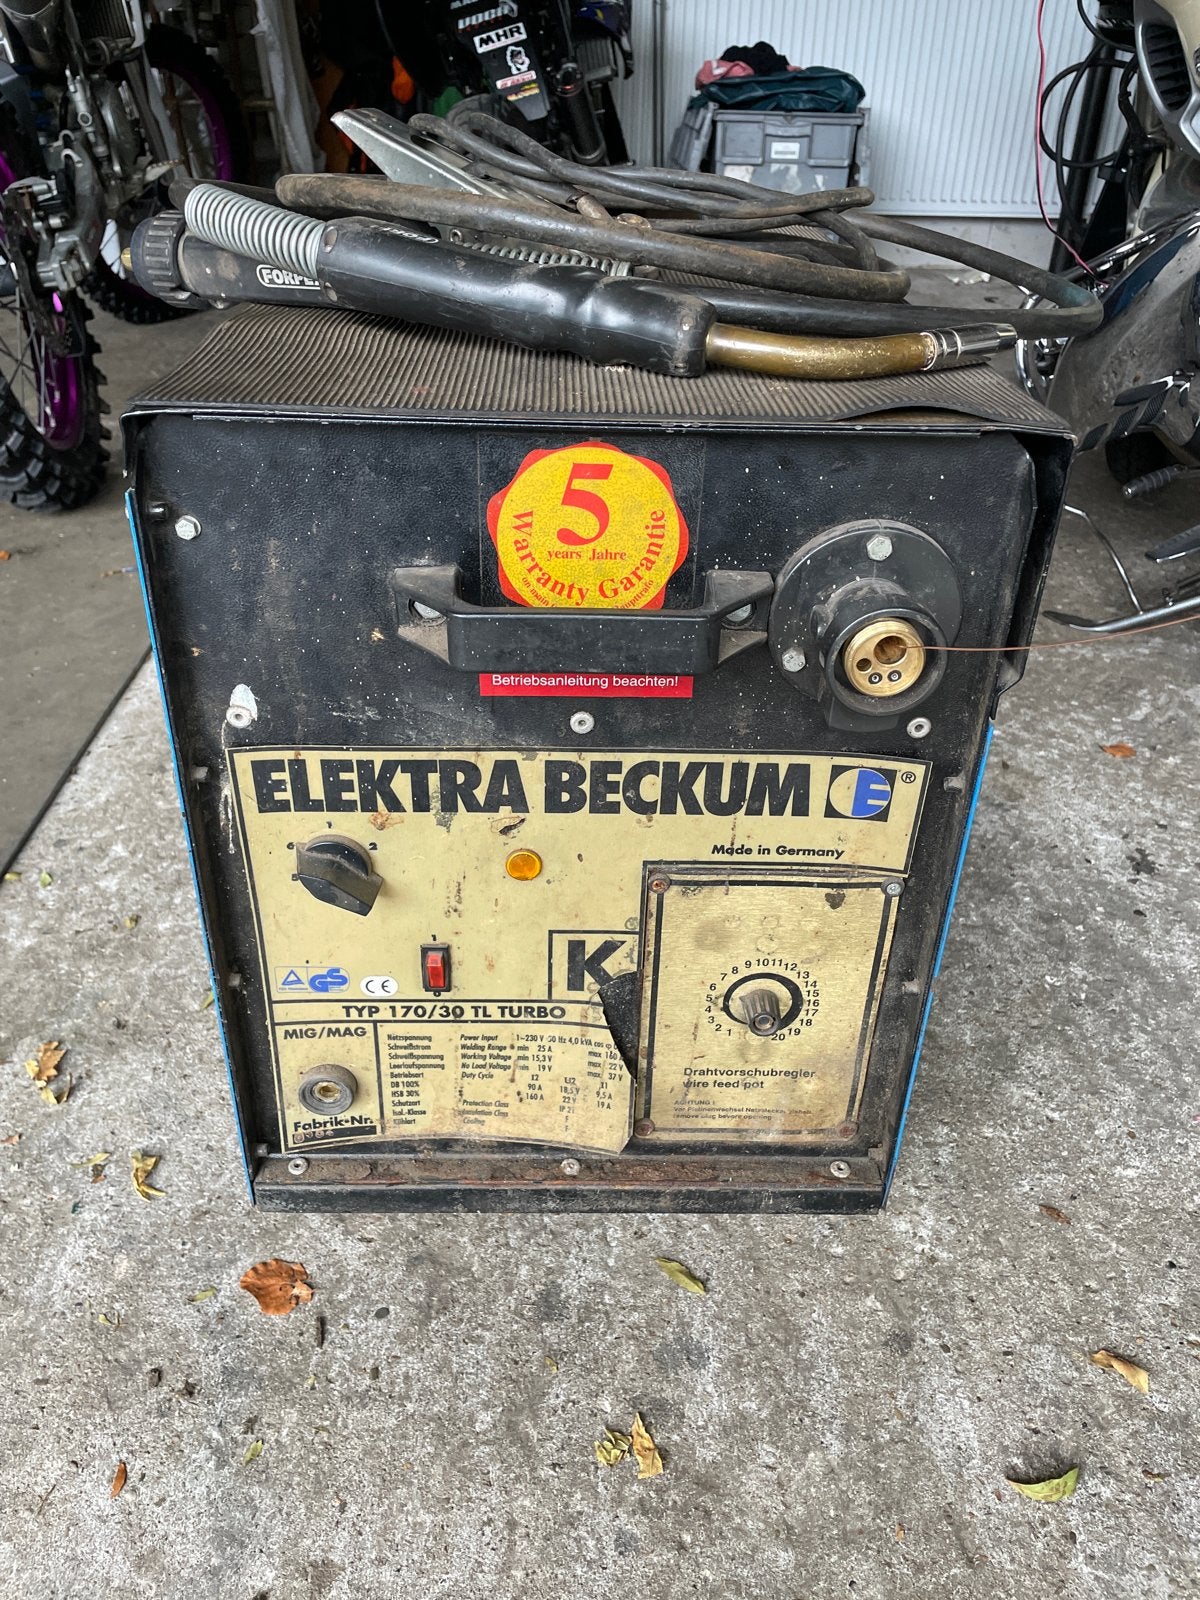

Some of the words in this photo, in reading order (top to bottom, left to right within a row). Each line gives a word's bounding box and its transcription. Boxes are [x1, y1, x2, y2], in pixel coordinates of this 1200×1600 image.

[480, 26, 523, 48] MHR
[261, 268, 320, 286] FORPE
[556, 463, 614, 546] 5
[512, 510, 589, 605] Warranty
[599, 509, 666, 599] Garantie
[547, 550, 582, 562] years
[589, 549, 627, 561] Jahre
[492, 674, 608, 688] Betriebsanleitung
[612, 676, 678, 688] beachten!
[250, 758, 530, 813] ELEKTRA
[544, 760, 811, 817] BECKUM
[368, 842, 378, 850] 2
[711, 845, 753, 856] Made
[757, 845, 771, 856] in
[776, 846, 845, 859] Germany
[567, 939, 627, 992] K
[745, 960, 752, 968] 9
[756, 959, 769, 967] 10
[771, 959, 783, 967] 11
[784, 963, 797, 971] 12
[732, 966, 738, 974] 8
[720, 973, 727, 981] 7
[796, 971, 810, 979] 13
[710, 983, 716, 991] 6
[804, 980, 817, 988] 14
[806, 989, 819, 997] 15
[706, 994, 713, 1002] 5
[807, 999, 820, 1007] 16
[342, 1005, 380, 1018] TYP
[388, 1005, 465, 1020] 170/30
[471, 1006, 492, 1018] TL
[497, 1005, 566, 1019] TURBO
[705, 1005, 711, 1013] 4
[805, 1008, 819, 1016] 17
[708, 1016, 715, 1024] 3
[799, 1018, 812, 1026] 18
[715, 1023, 722, 1031] 2
[283, 1027, 367, 1040] MIG/MAG
[788, 1028, 801, 1036] 19
[771, 1033, 785, 1041] 20
[568, 1037, 579, 1045] 4,0
[580, 1037, 592, 1046] kVA
[387, 1042, 431, 1050] Schweißstrom
[460, 1043, 485, 1051] Welding
[487, 1043, 507, 1051] Range
[388, 1052, 444, 1060] Schweißspannung
[460, 1053, 486, 1061] Working
[488, 1053, 511, 1061] Voltage
[532, 1054, 546, 1062] 15,3
[587, 1060, 601, 1068] max
[609, 1062, 617, 1070] 22
[389, 1062, 445, 1070] Leerlaufspannung
[488, 1062, 511, 1071] Voltage
[608, 1072, 617, 1080] 37
[683, 1067, 816, 1079] Drahtvorschubregler
[682, 1079, 709, 1088] wire
[713, 1079, 739, 1088] feed
[743, 1080, 764, 1090] pot
[560, 1086, 573, 1094] 18,5
[293, 1115, 374, 1132] Fabrik-Nr.
